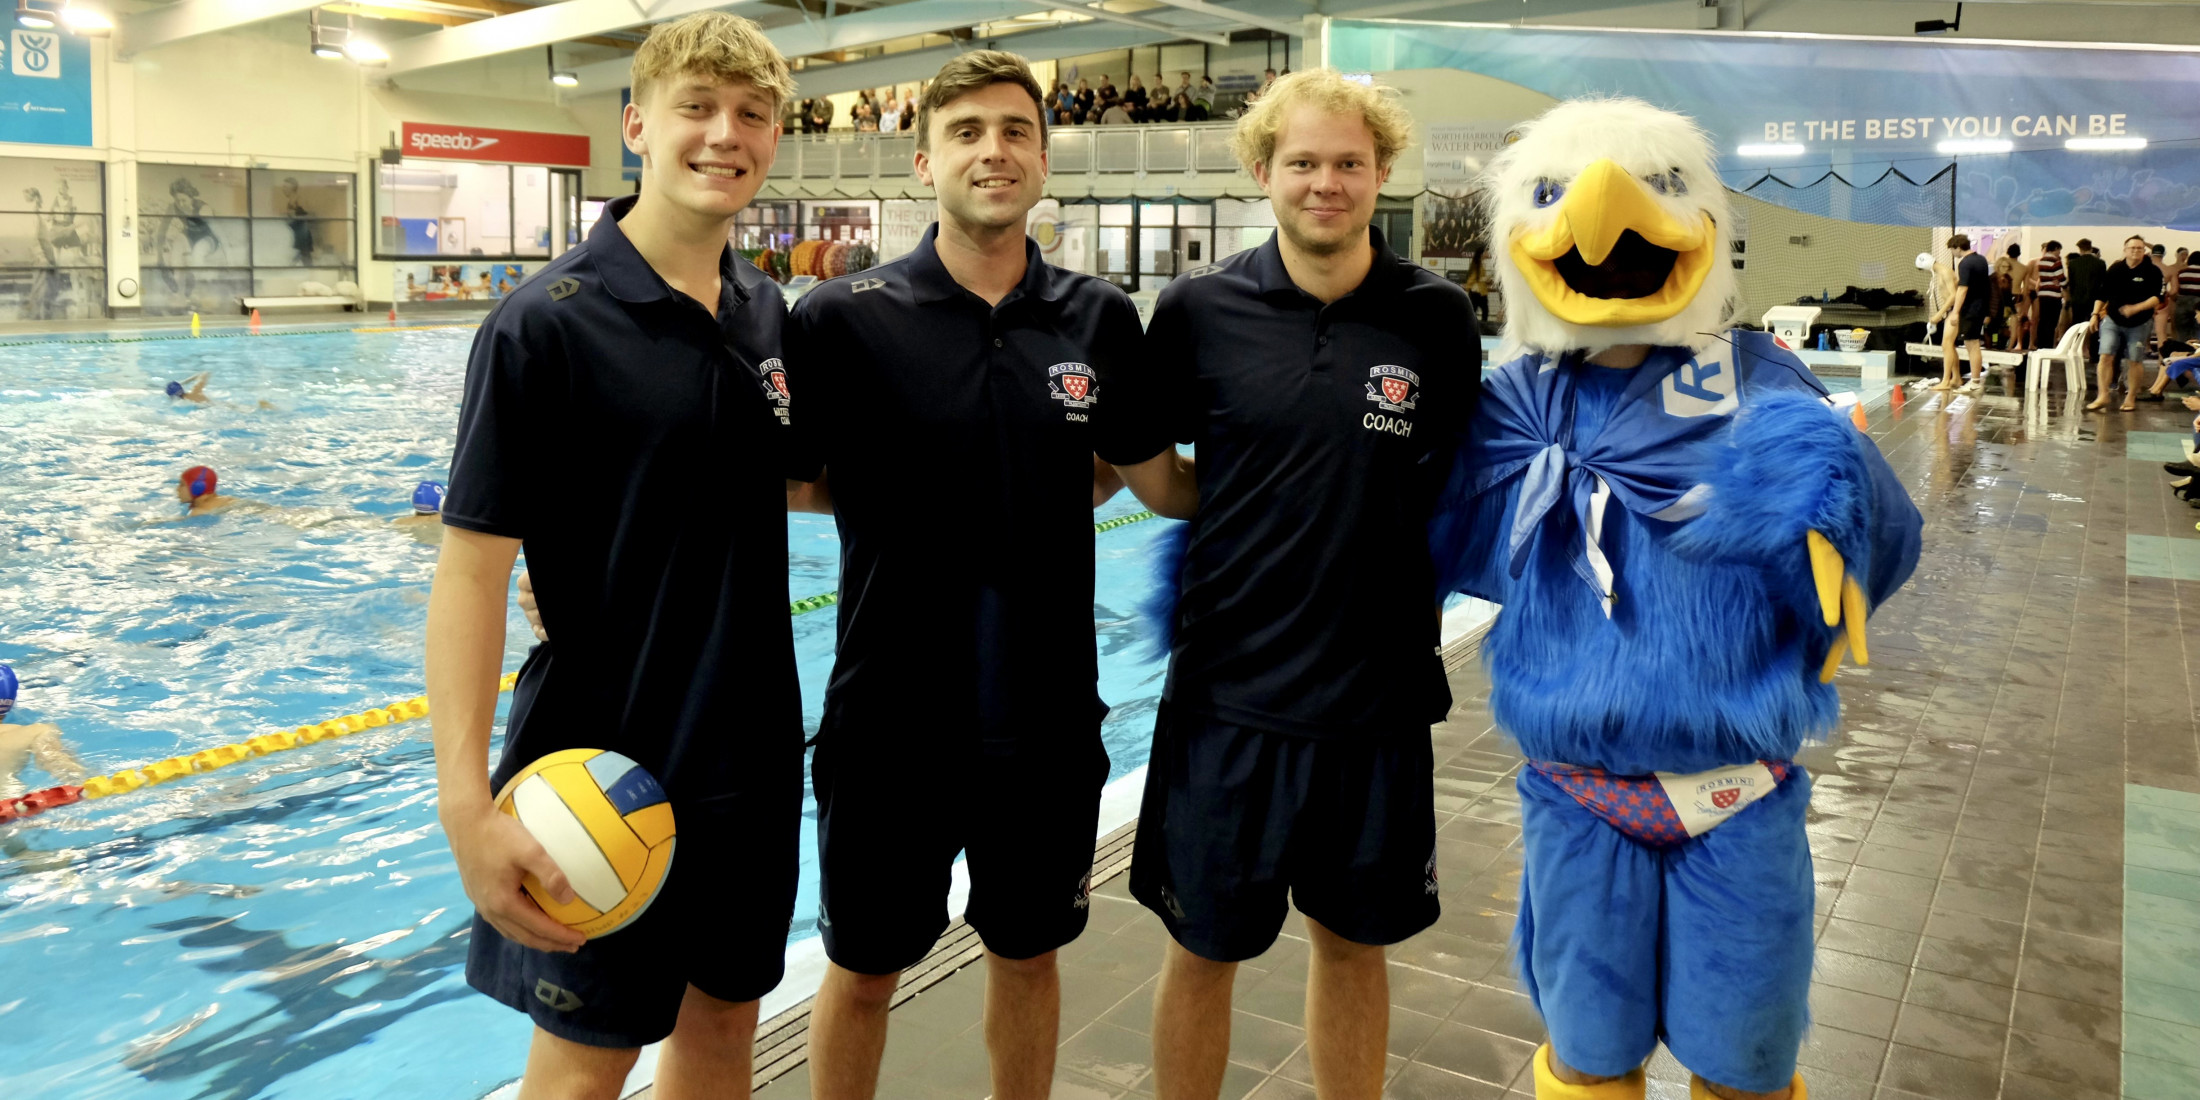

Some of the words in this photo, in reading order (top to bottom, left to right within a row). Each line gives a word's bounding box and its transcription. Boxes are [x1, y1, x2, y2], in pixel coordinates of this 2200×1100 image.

[1764, 121, 1796, 142] BE
[1804, 119, 1856, 141] THE
[1865, 117, 1935, 140] BEST
[1942, 116, 2002, 138] YOU
[2010, 114, 2077, 137] CAN
[2088, 113, 2127, 136] BE
[411, 132, 473, 150] speedo
[1432, 133, 1461, 141] NORTH
[1432, 141, 1470, 151] WATER
[1473, 141, 1504, 151] POLO
[886, 209, 911, 222] THE
[914, 209, 939, 223] CLU
[886, 224, 919, 237] WITH
[1373, 366, 1418, 384] ROSMINI
[1066, 412, 1089, 422] COACH
[1363, 412, 1412, 438] COACH
[1700, 777, 1753, 791] ROSMINI
